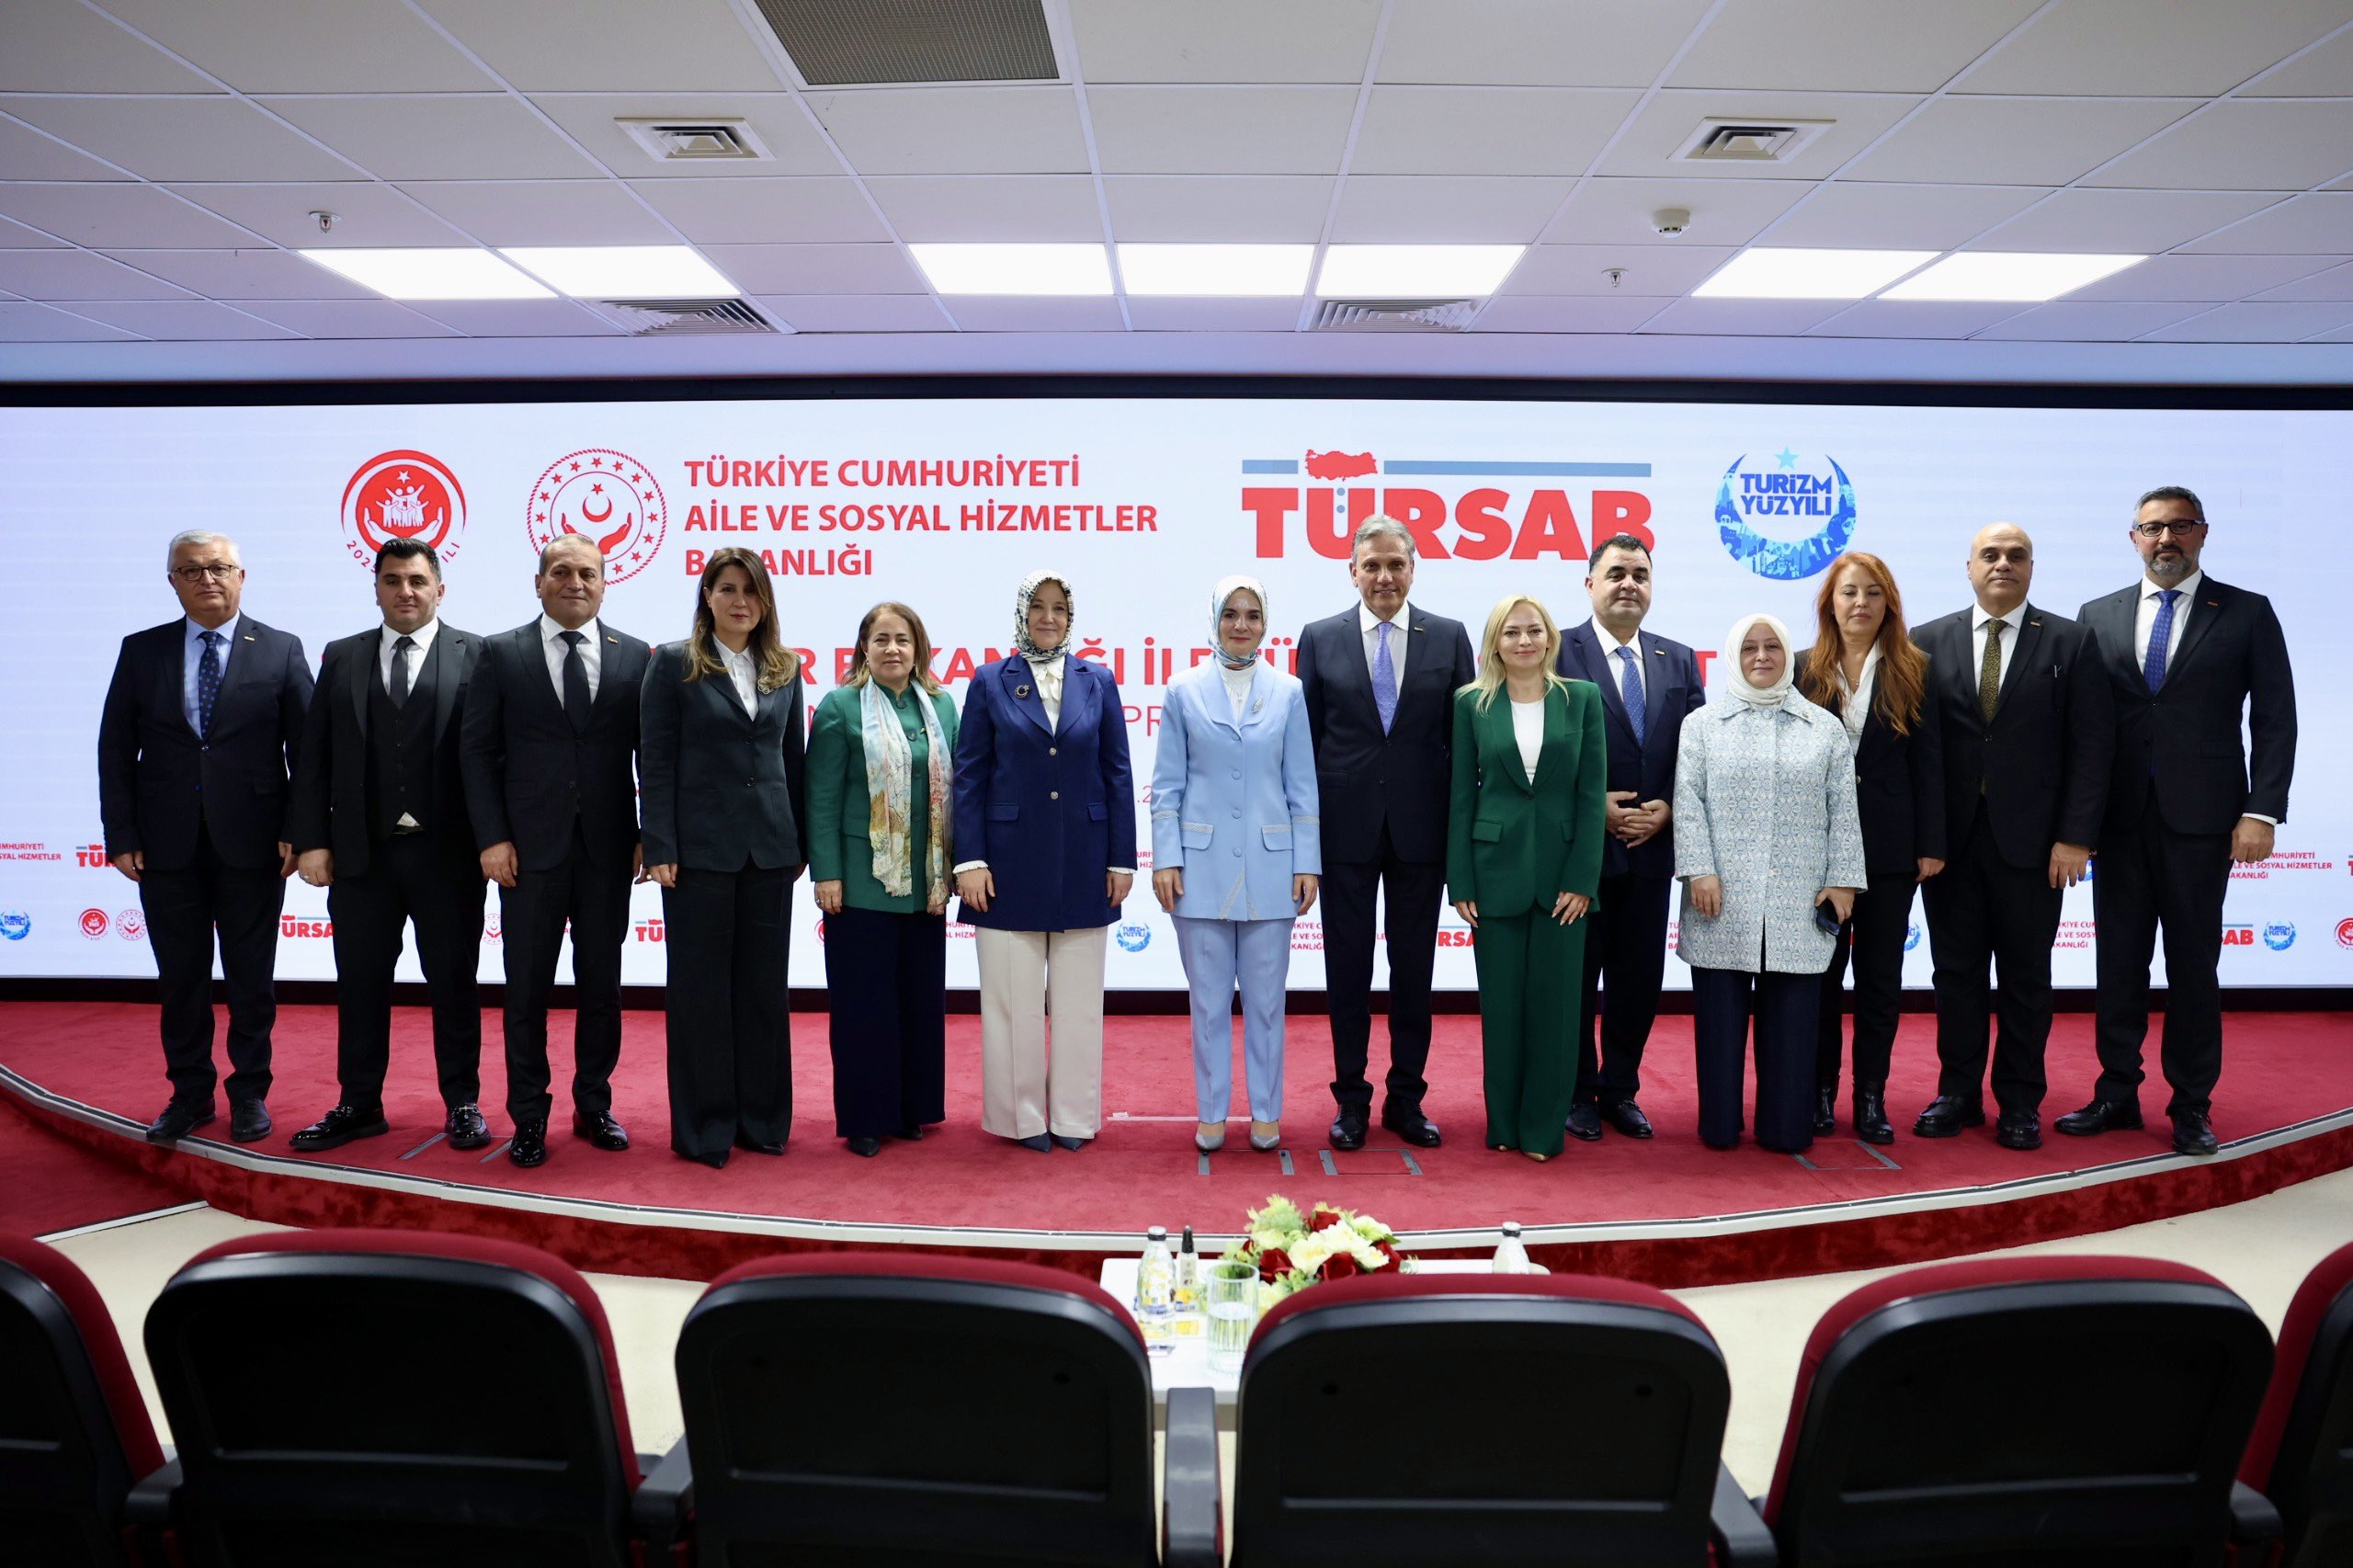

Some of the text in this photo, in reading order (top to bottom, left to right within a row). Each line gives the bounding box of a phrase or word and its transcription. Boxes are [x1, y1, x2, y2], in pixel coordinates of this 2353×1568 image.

[684, 453, 1080, 487] TÜRKİYE CUMHURİYETİ
[685, 499, 1158, 532] AİLE VE SOSYAL HİZMETLER
[1740, 494, 1833, 517] YÜZYILI
[1241, 486, 1656, 561] TÜRSAB
[685, 543, 872, 576] BANLIĞI
[2230, 871, 2268, 880] AKANLIĞI
